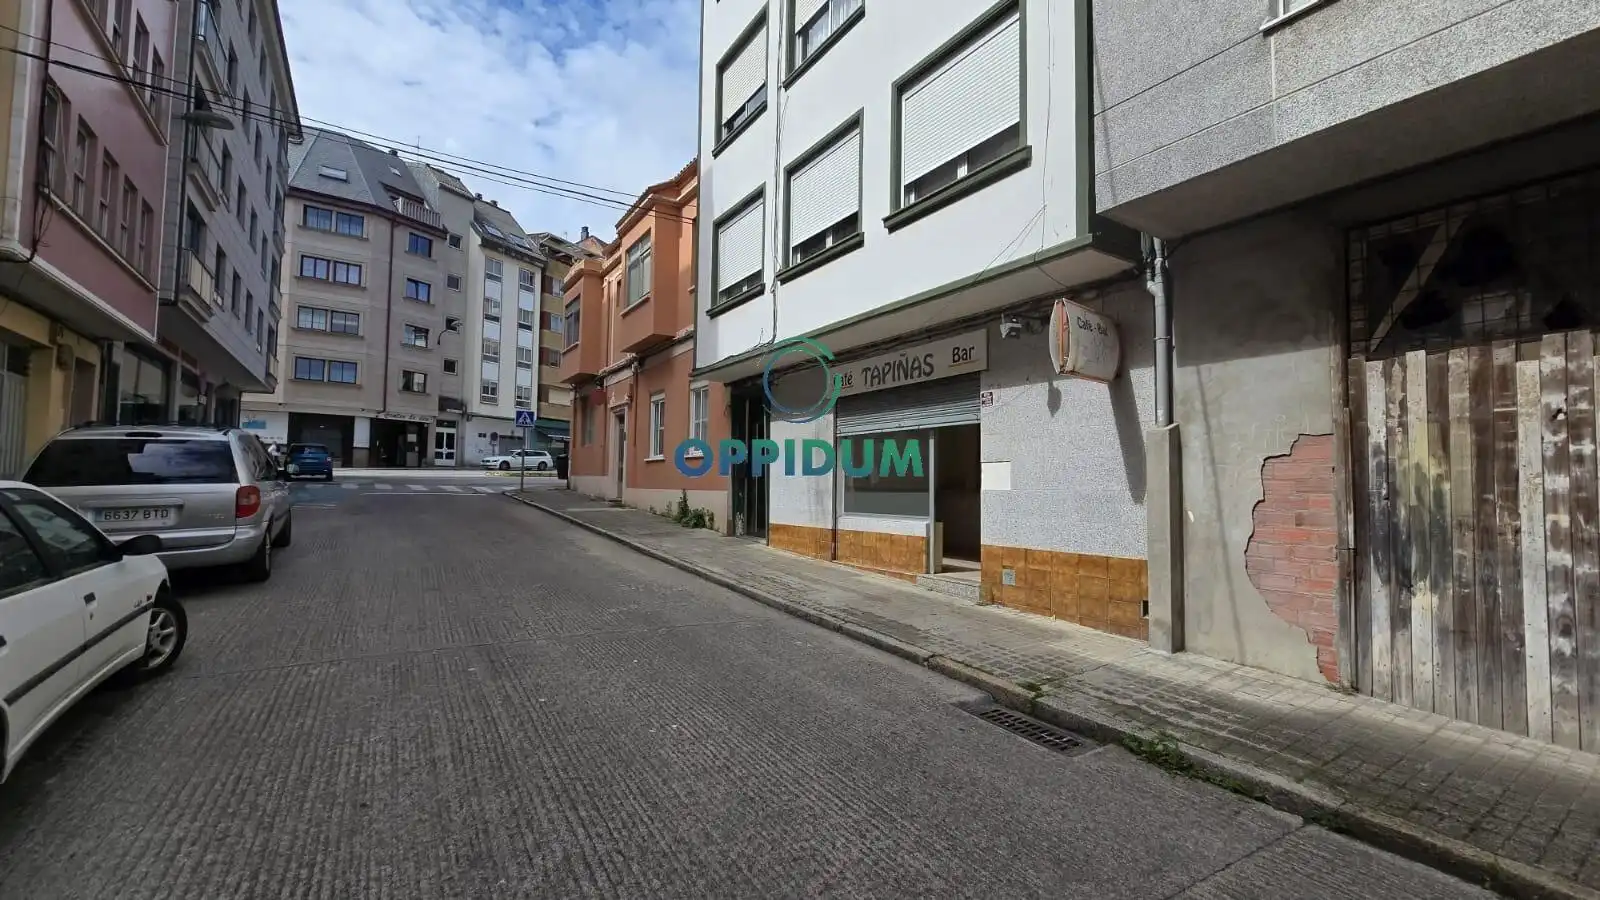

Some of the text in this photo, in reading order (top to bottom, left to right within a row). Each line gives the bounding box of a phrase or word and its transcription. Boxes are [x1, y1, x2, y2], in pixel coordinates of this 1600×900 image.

[834, 345, 975, 387] afé TAPIÑAS Bar
[104, 509, 169, 520] 6637 BTD
